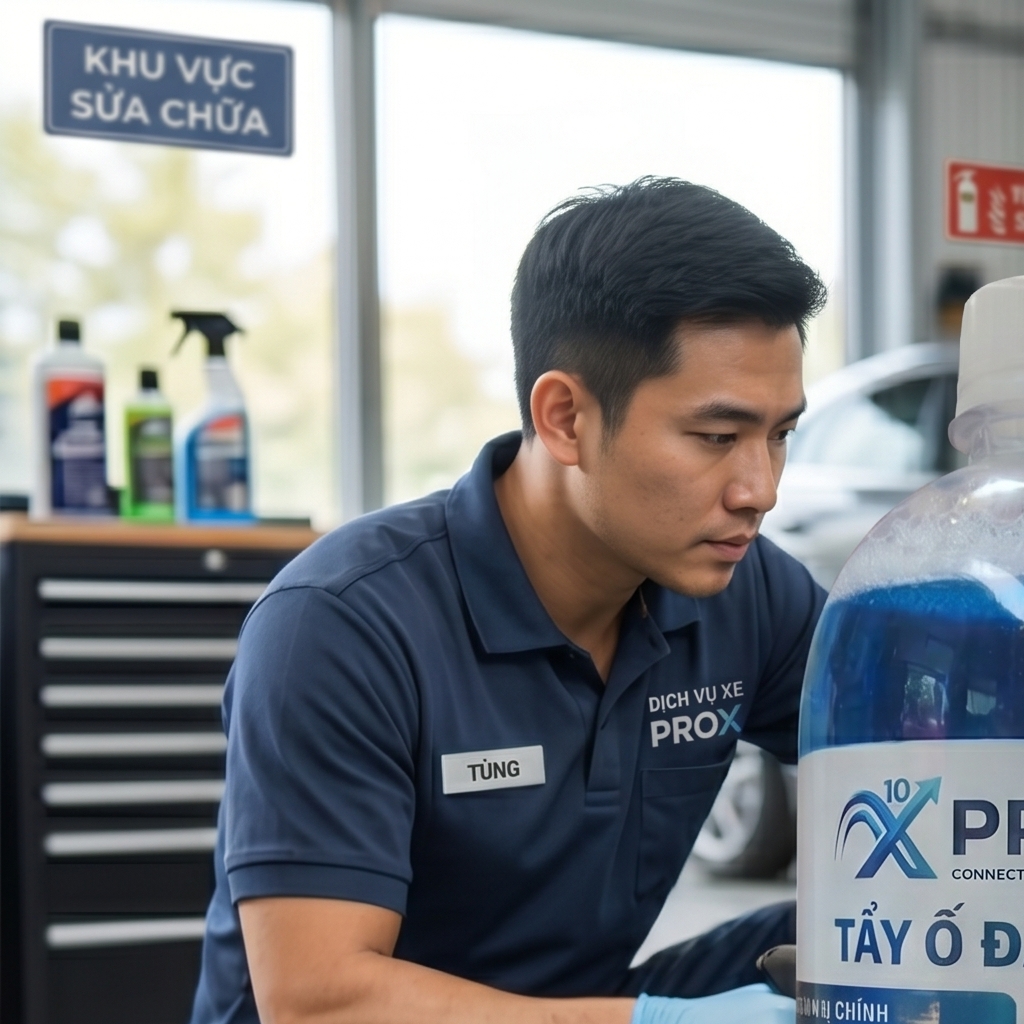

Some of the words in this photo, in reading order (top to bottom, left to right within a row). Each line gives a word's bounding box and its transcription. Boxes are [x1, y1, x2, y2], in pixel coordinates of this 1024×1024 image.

[84, 45, 165, 81] KHU
[175, 54, 255, 93] VỰC
[159, 97, 269, 137] CHỮA
[649, 691, 689, 713] DỊCH
[693, 686, 717, 705] VỤ
[721, 681, 744, 699] XE
[650, 704, 742, 748] PROX
[883, 778, 911, 804] 10
[834, 901, 913, 965] TẨY
[925, 902, 966, 967] Ố
[835, 997, 888, 1023] CHÍNH
